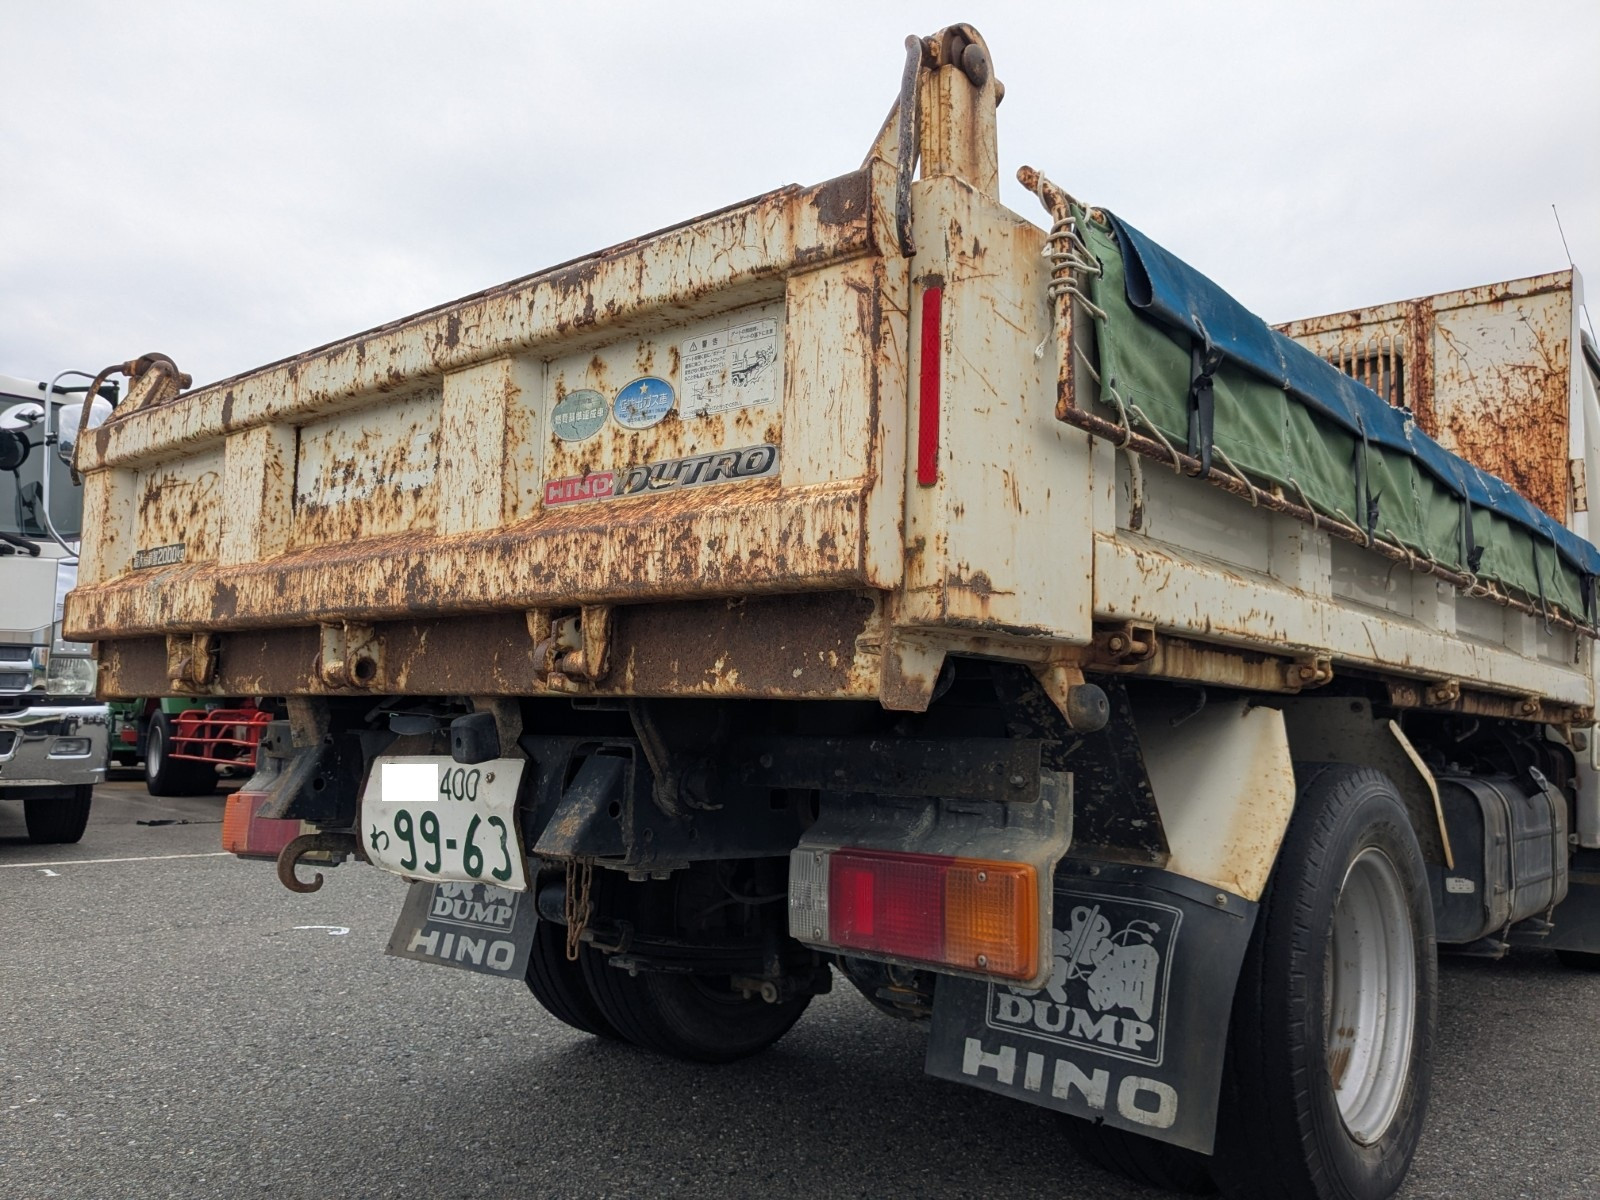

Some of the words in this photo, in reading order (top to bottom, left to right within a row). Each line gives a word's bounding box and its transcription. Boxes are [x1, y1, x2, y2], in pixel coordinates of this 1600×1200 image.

[549, 477, 612, 500] HINO
[614, 446, 776, 496] DUTRO
[440, 768, 480, 801] 400
[370, 824, 390, 853] わ
[394, 809, 512, 881] 99-63
[432, 897, 513, 925] DUMP
[407, 928, 516, 971] HINO
[996, 993, 1155, 1051] DUMP
[962, 1037, 1178, 1129] HINO
